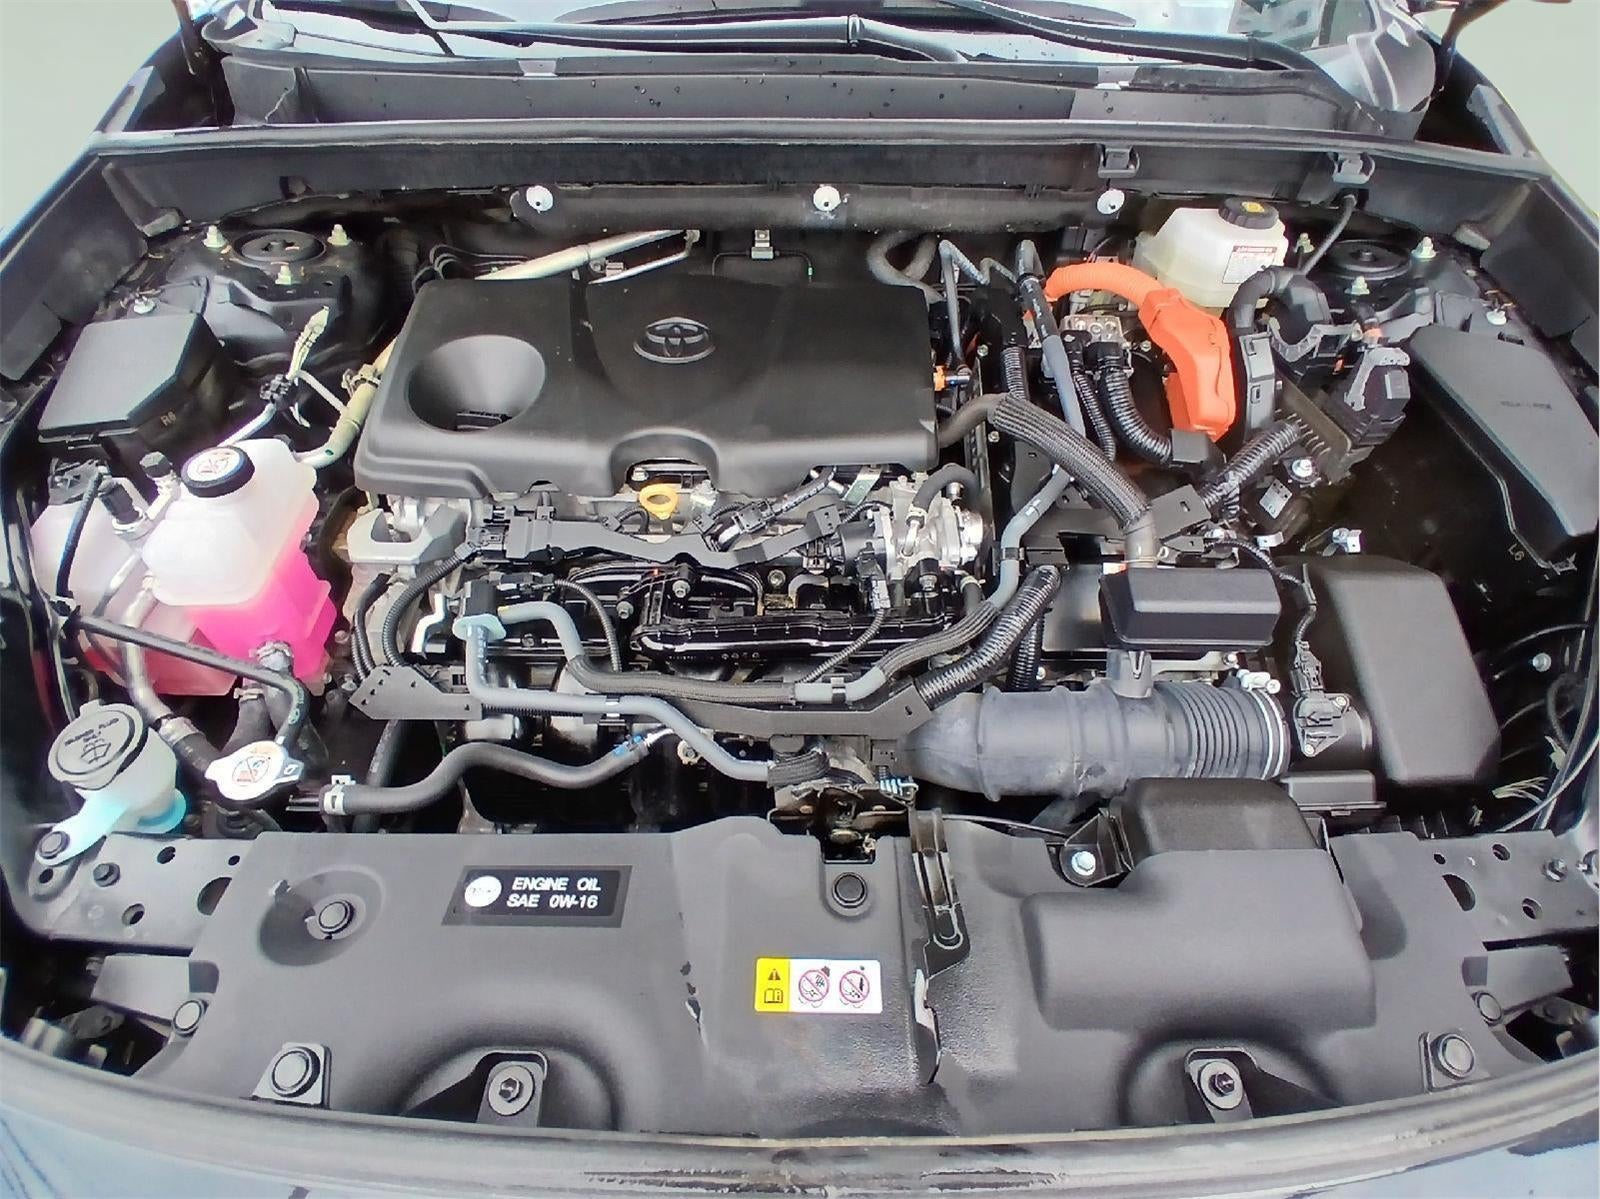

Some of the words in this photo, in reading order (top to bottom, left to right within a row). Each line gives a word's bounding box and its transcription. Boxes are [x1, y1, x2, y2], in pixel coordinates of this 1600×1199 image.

[512, 877, 569, 891] ENGINE
[577, 877, 601, 891] OIL
[506, 894, 540, 908] SAE
[549, 895, 598, 908] 0W-16
